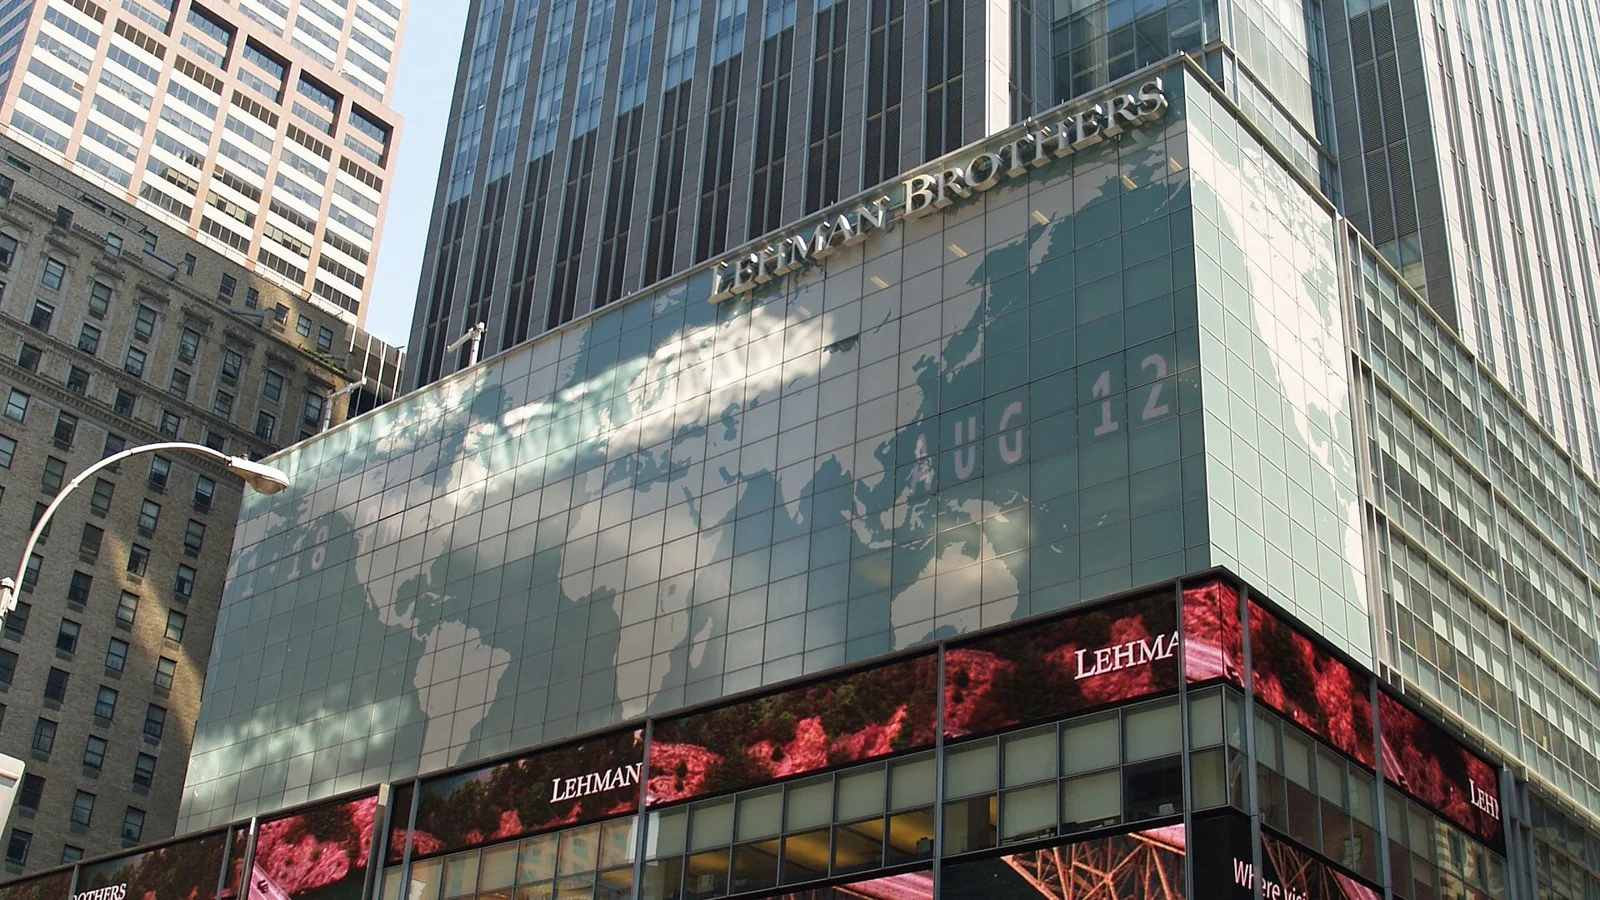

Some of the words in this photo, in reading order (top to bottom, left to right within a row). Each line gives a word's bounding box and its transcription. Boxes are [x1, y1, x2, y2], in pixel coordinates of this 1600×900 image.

[707, 195, 890, 304] LEHMAN
[901, 77, 1168, 217] BROTHERS
[909, 401, 1022, 495] AUG
[1092, 354, 1169, 437] 12
[550, 762, 643, 803] LEHMAN
[73, 883, 127, 900] OTHERS
